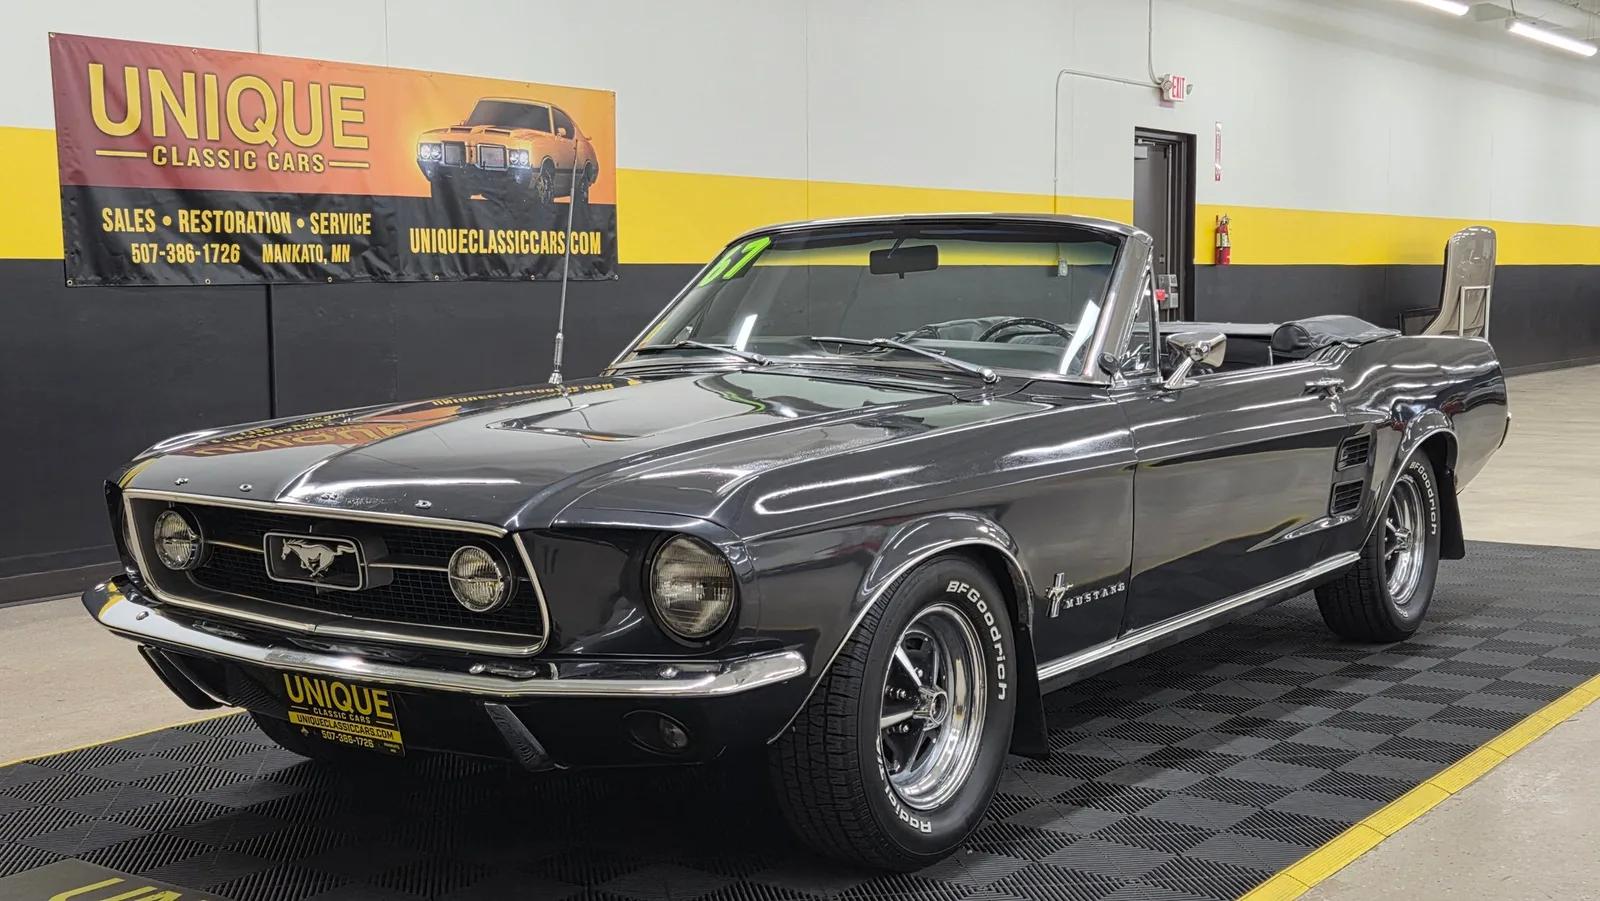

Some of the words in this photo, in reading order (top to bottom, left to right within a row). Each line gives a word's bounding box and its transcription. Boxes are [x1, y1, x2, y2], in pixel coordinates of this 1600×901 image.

[1172, 76, 1184, 99] EXIT
[88, 63, 369, 150] UNIQUE
[152, 145, 257, 170] CLASSIC
[267, 151, 325, 173] CARS
[102, 208, 156, 233] SALES
[178, 209, 292, 234] RESTORATION
[310, 212, 371, 235] SERVICE
[131, 243, 240, 264] 507-386-1726
[262, 244, 328, 265] MANKATO,
[331, 245, 350, 263] MN
[409, 228, 601, 255] UNIQUECLASSICCARSCOM
[1064, 582, 1126, 609] MUSTANG
[947, 580, 1006, 700] BFGoodrich
[283, 674, 393, 719] UNIQUE
[297, 714, 394, 740] UNIQUECLASSICCARS.COM
[313, 707, 347, 720] CLASSIC
[349, 714, 371, 724] CARS
